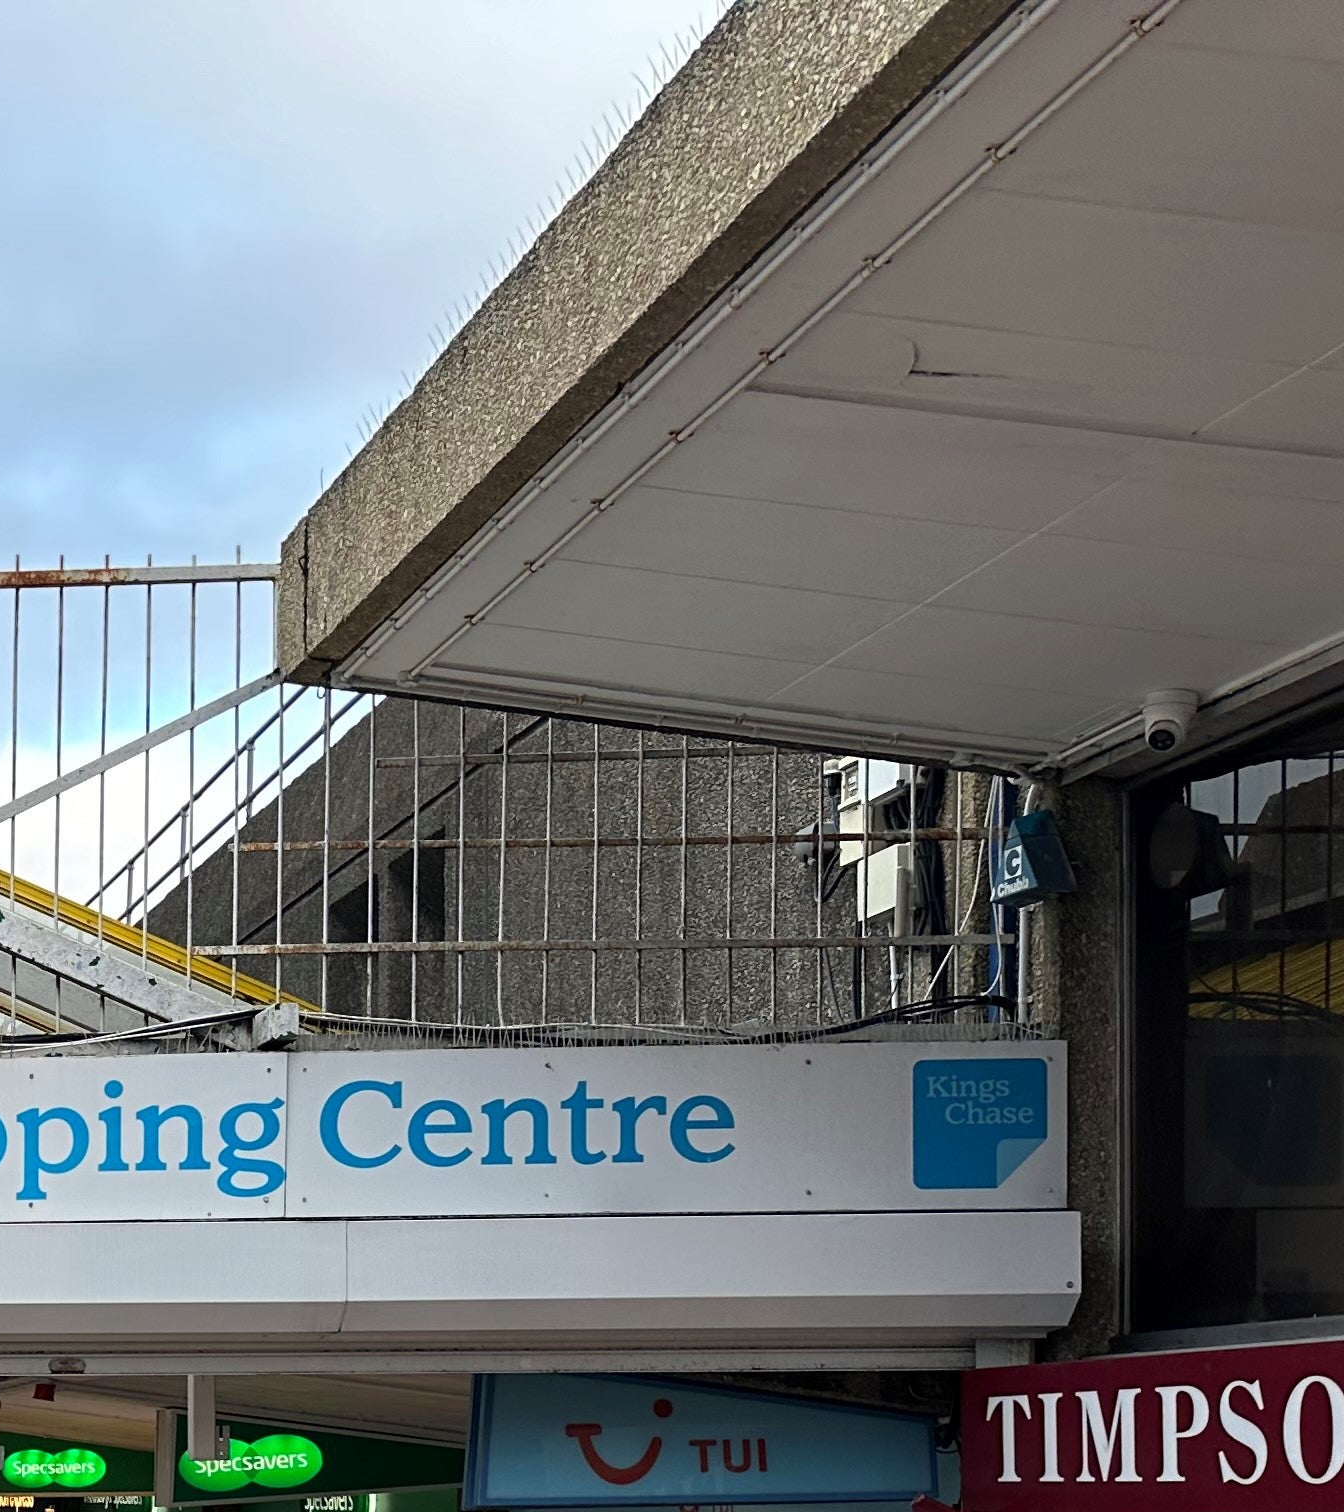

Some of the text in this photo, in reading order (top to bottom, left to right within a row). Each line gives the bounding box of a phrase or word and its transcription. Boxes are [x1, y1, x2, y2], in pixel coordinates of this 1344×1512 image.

[926, 1075, 1010, 1102] Kings
[319, 1080, 736, 1169] Centre
[944, 1101, 1034, 1125] Chase
[985, 1375, 1344, 1485] TIMPSO
[13, 1460, 96, 1478] Specsavers
[689, 1438, 768, 1474] TUI
